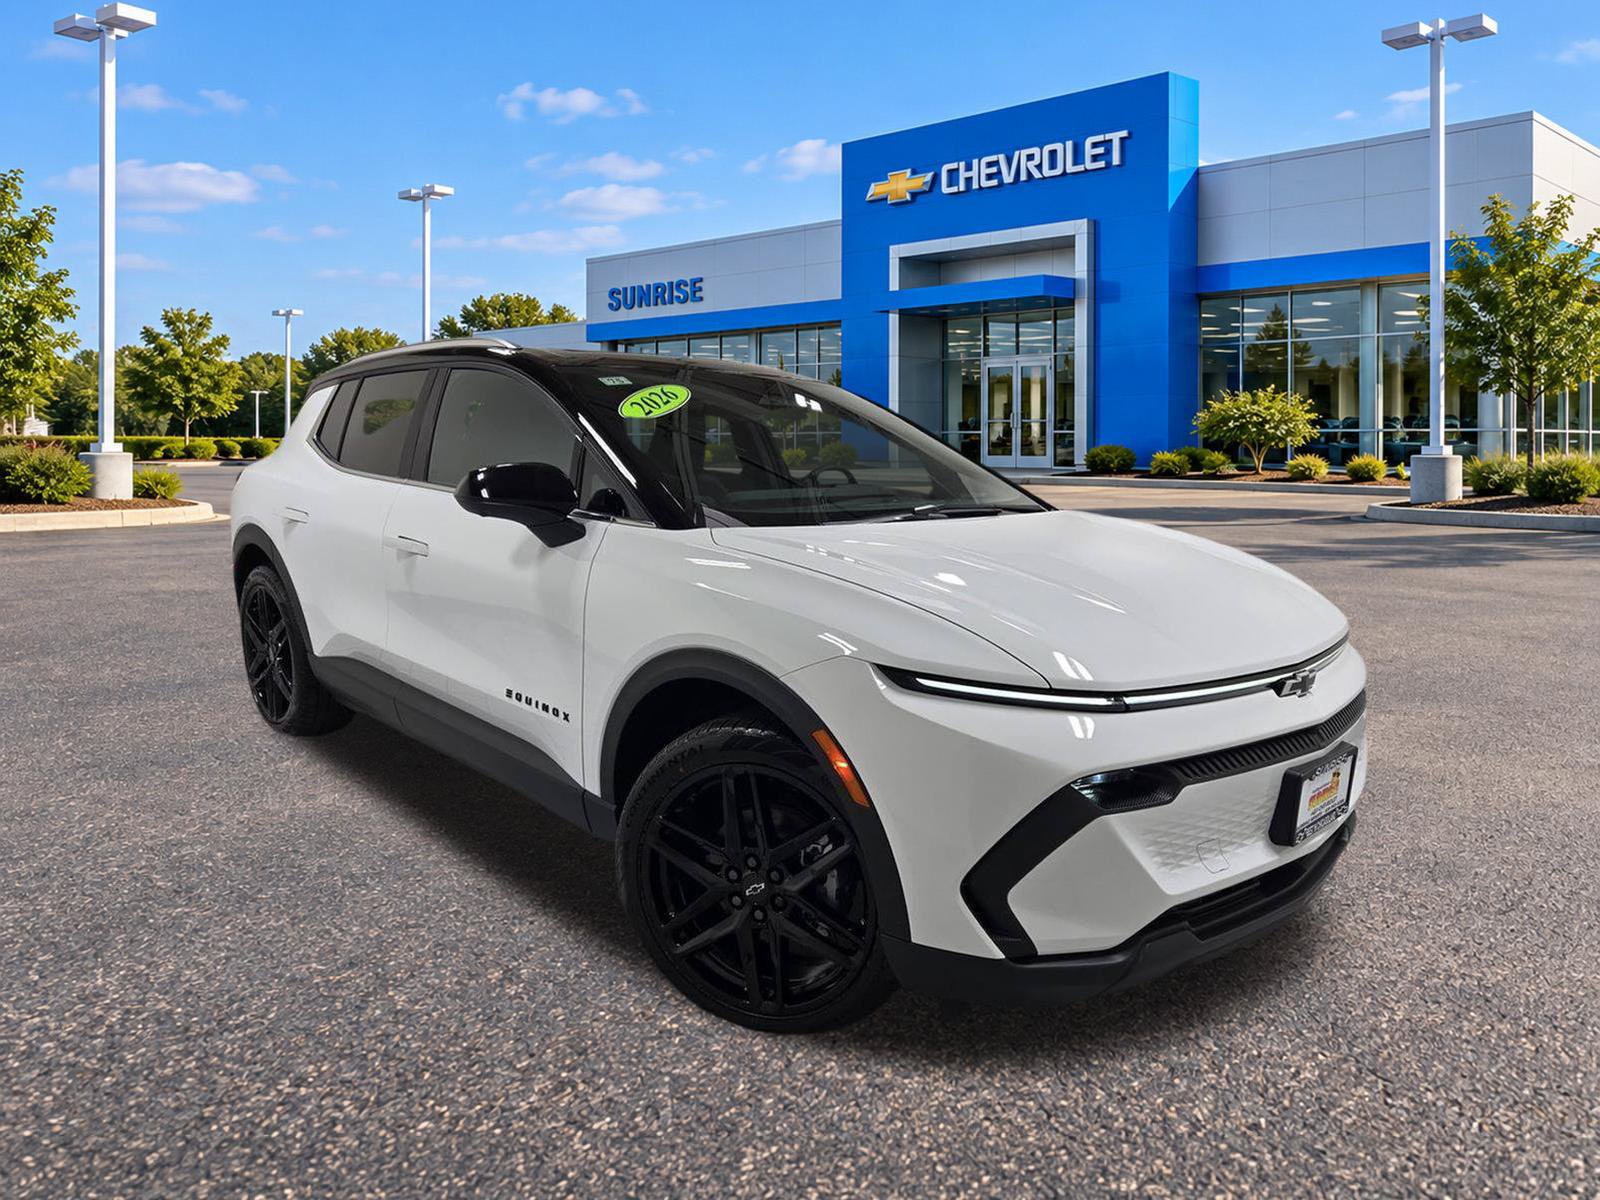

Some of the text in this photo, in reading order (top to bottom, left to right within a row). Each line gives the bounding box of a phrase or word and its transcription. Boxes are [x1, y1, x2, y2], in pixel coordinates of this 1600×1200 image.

[940, 130, 1129, 195] CHEVROLET
[607, 277, 704, 312] SUNRISE
[630, 387, 679, 416] 2026
[505, 688, 571, 723] EQUINOX
